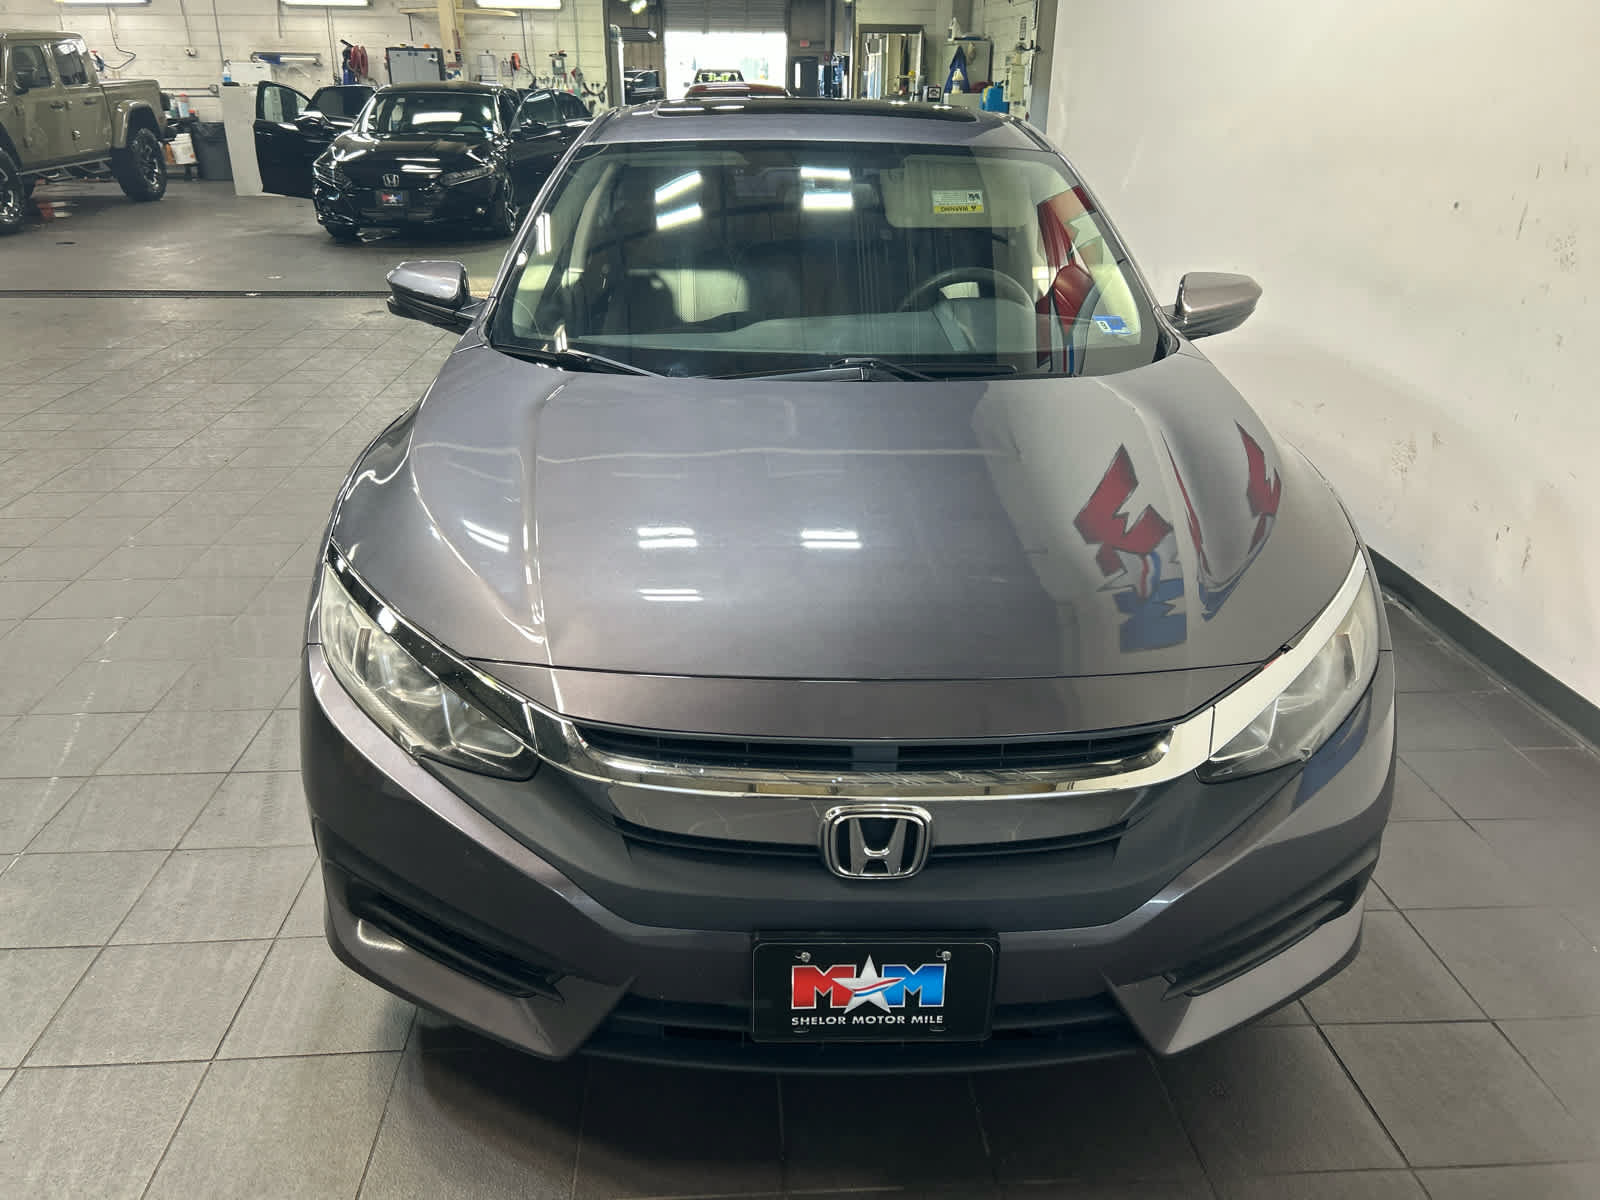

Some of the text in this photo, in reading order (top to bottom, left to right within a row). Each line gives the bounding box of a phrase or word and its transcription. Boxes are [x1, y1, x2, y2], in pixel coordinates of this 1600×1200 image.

[791, 1015, 944, 1026] SHELOR MOTOR MILE
